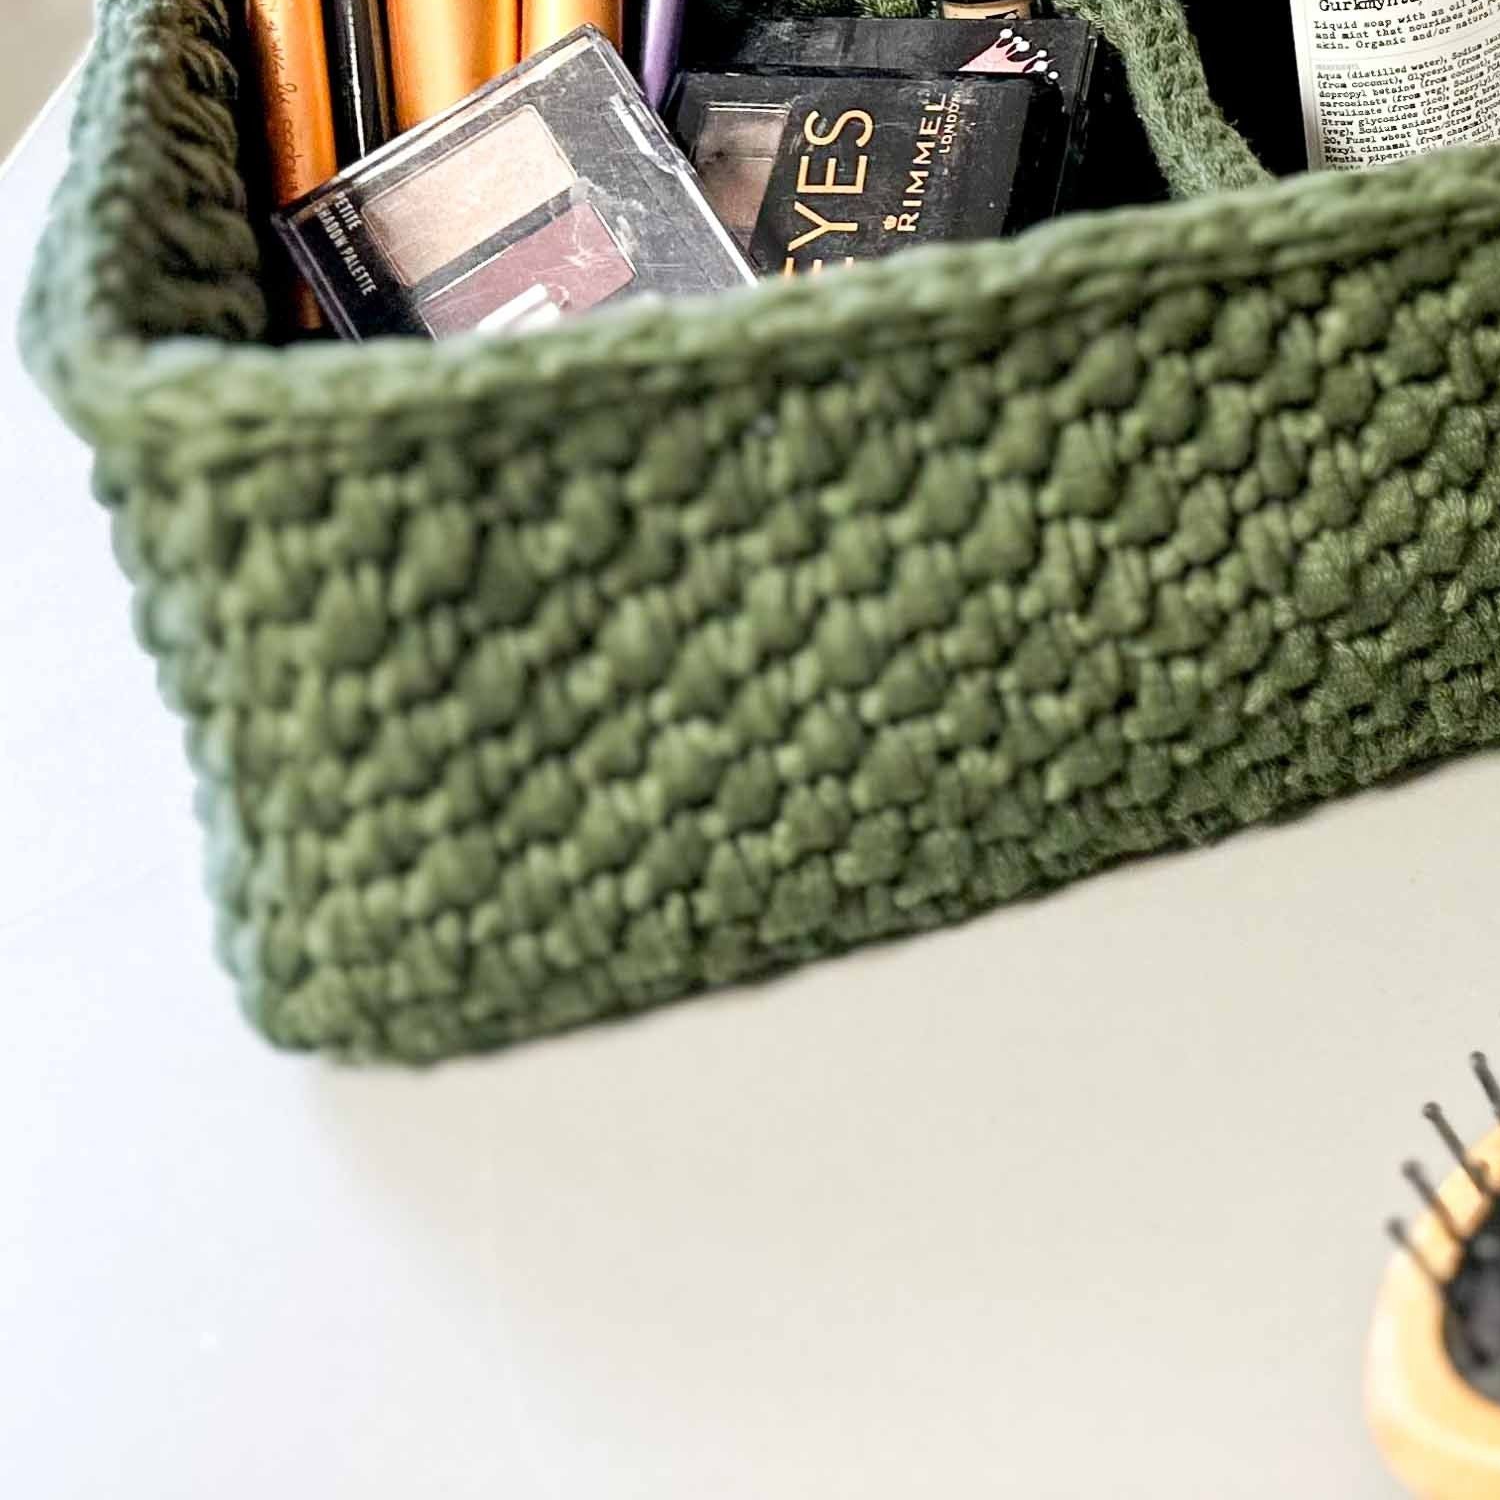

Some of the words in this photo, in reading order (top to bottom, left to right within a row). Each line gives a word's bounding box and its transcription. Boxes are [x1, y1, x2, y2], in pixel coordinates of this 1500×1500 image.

[1313, 20, 1357, 31] Liquid
[1364, 19, 1392, 28] soap
[1398, 11, 1426, 23] with
[1449, 0, 1467, 11] oil
[1315, 31, 1336, 39] and
[1341, 30, 1369, 39] mint
[1376, 26, 1403, 37] that
[1409, 12, 1463, 32] nourishes
[1467, 2, 1483, 15] and
[1315, 41, 1349, 50] skin.
[1355, 37, 1406, 49] Organic
[1412, 26, 1451, 41] and/or
[1456, 8, 1493, 29] natural
[1317, 71, 1342, 80] Aqua
[1347, 64, 1407, 79] (distilled
[1318, 80, 1347, 89] (from
[1420, 77, 1447, 88] (from
[1393, 93, 1420, 103] (from
[1387, 103, 1415, 113] (from
[1321, 118, 1353, 126] Straw
[897, 92, 946, 231] RIMMEL
[314, 202, 349, 249] SHADOW
[340, 245, 378, 297] PALETTE
